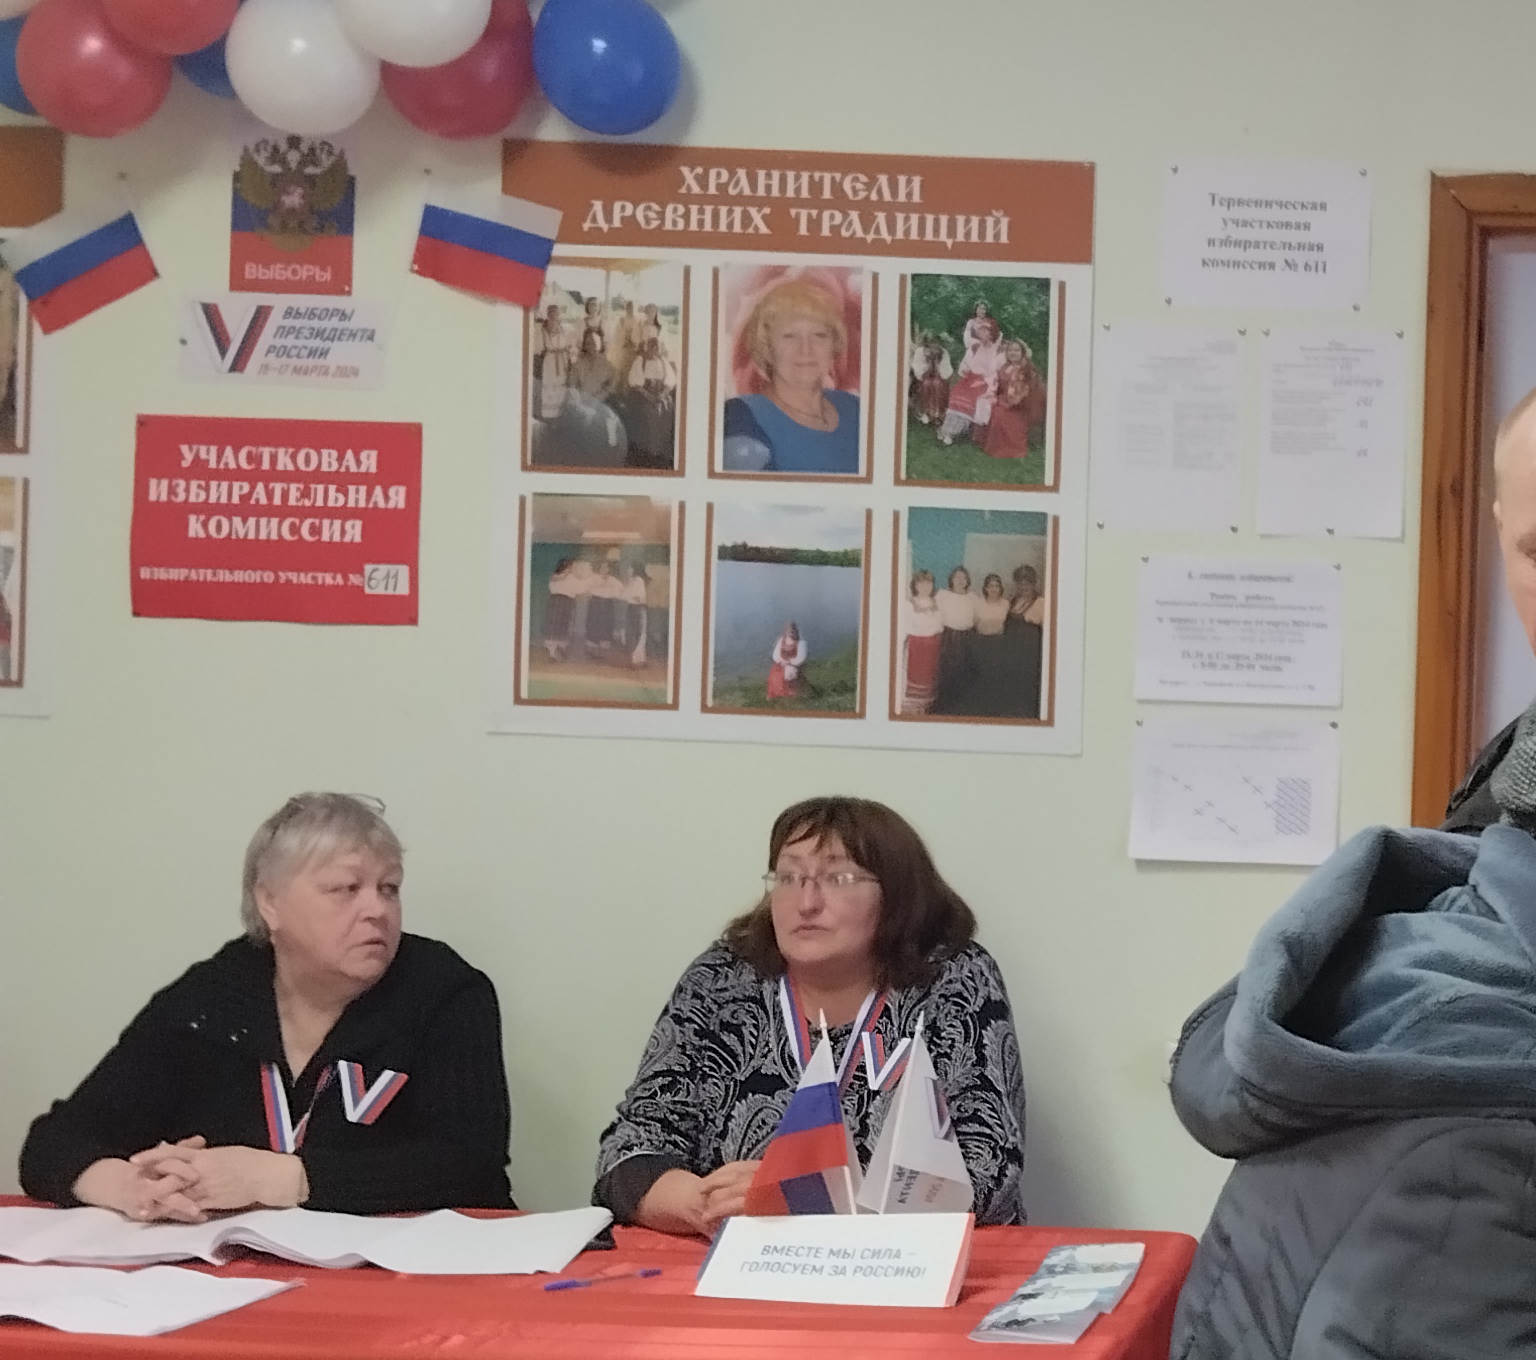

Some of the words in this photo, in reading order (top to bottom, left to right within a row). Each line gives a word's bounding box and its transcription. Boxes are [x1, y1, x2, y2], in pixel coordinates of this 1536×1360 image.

[677, 165, 924, 203] ХРАНИТЕЛИ
[581, 199, 773, 235] ДРЕВНИХ
[789, 206, 1011, 250] ТРАДИЦИЙ
[1220, 217, 1312, 232] участковая
[1207, 234, 1325, 253] избирательная
[244, 261, 332, 283] ВЫБОРЫ
[1201, 257, 1277, 272] комиссия
[1303, 259, 1328, 275] 611
[282, 305, 355, 323] ВЫБОРЫ
[273, 325, 377, 343] ПРЕЗИДЕНТА
[264, 344, 331, 361] РОССИИ
[290, 364, 330, 378] МАРТА
[179, 444, 379, 474] УЧАСТКОВАЯ
[148, 477, 407, 509] ИЗБИРАТЕЛЬНАЯ
[187, 514, 363, 543] КОМИССИЯ
[139, 566, 275, 584] ИЗБИРАТЕЛЬНОГО
[278, 570, 344, 586] УЧАСТКА
[366, 567, 400, 593] 611
[760, 1244, 824, 1259] ВМЕСТЕ
[827, 1247, 857, 1260] МЫ
[860, 1248, 902, 1261] СИЛА
[740, 1260, 825, 1277] ГОЛОСУЕМ
[827, 1264, 848, 1277] ЗА
[852, 1265, 928, 1279] РОССИЮ!
